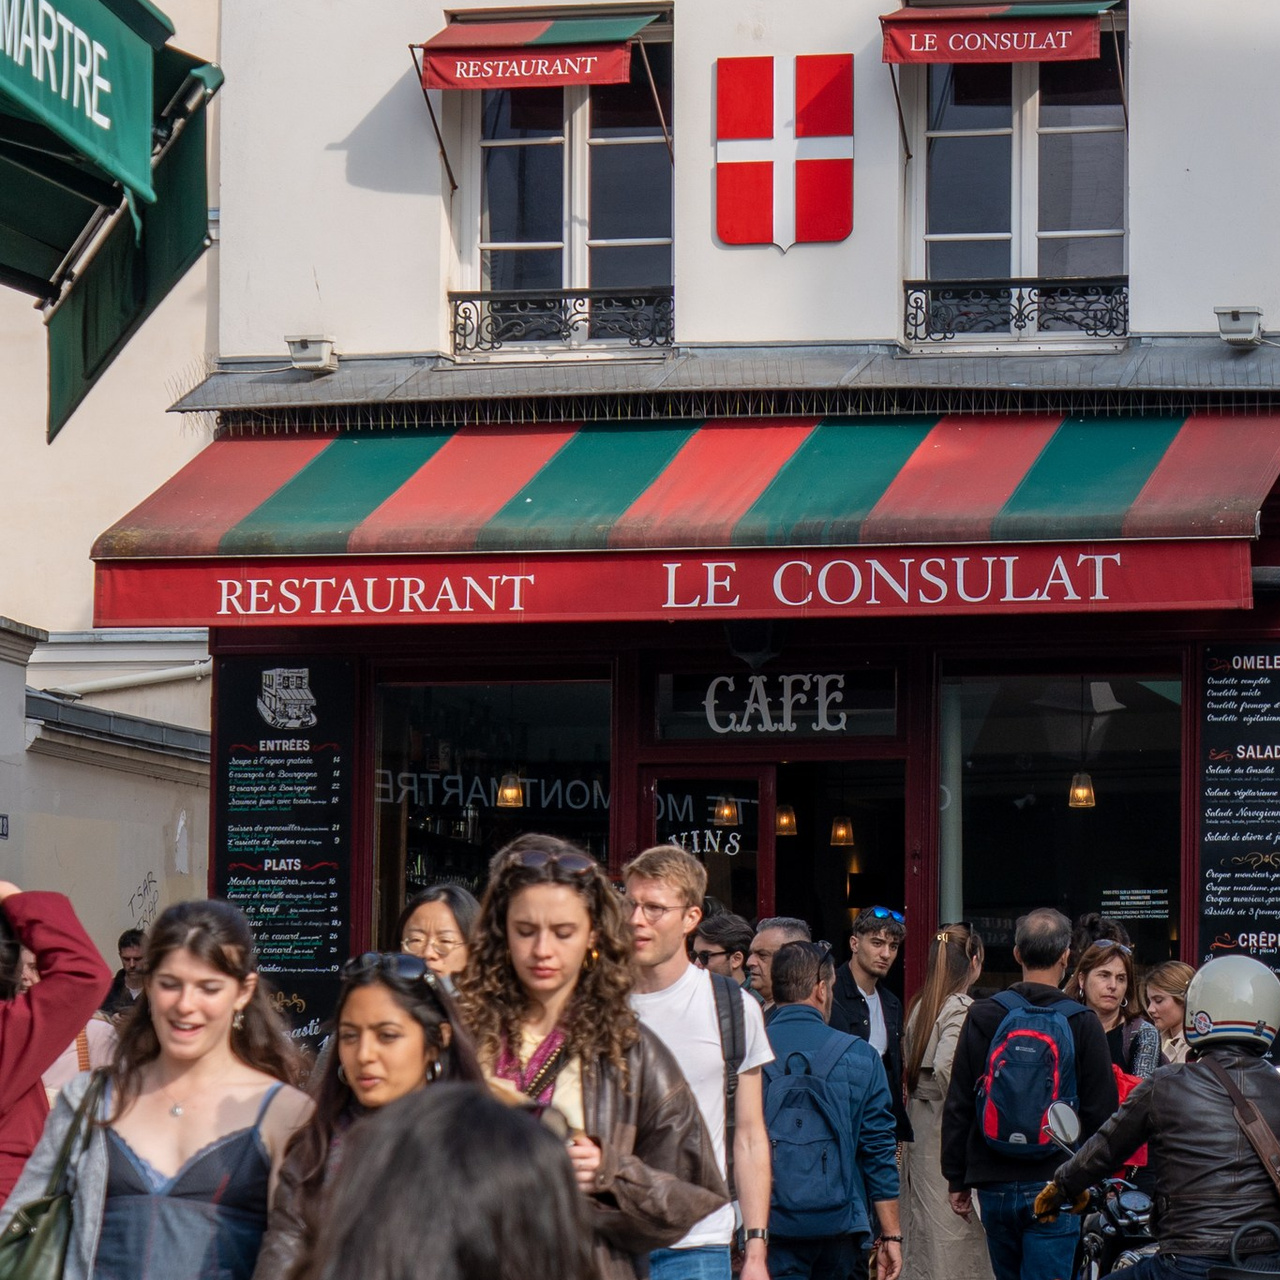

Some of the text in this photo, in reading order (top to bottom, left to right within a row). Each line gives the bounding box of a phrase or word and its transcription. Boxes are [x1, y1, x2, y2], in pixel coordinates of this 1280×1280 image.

[910, 29, 1073, 52] LE CONSULAT
[454, 55, 598, 80] RESTAURANT
[661, 552, 1121, 609] LE CONSULAT
[216, 573, 536, 615] RESTAURANT
[1206, 765, 1231, 774] Salade
[1246, 765, 1275, 774] Consulat
[1205, 788, 1231, 796] Salade
[1205, 808, 1233, 817] Salade
[668, 829, 742, 856] VINS
[1205, 832, 1230, 841] Salade
[264, 859, 302, 871] PLATS
[1249, 907, 1254, 915] 3
